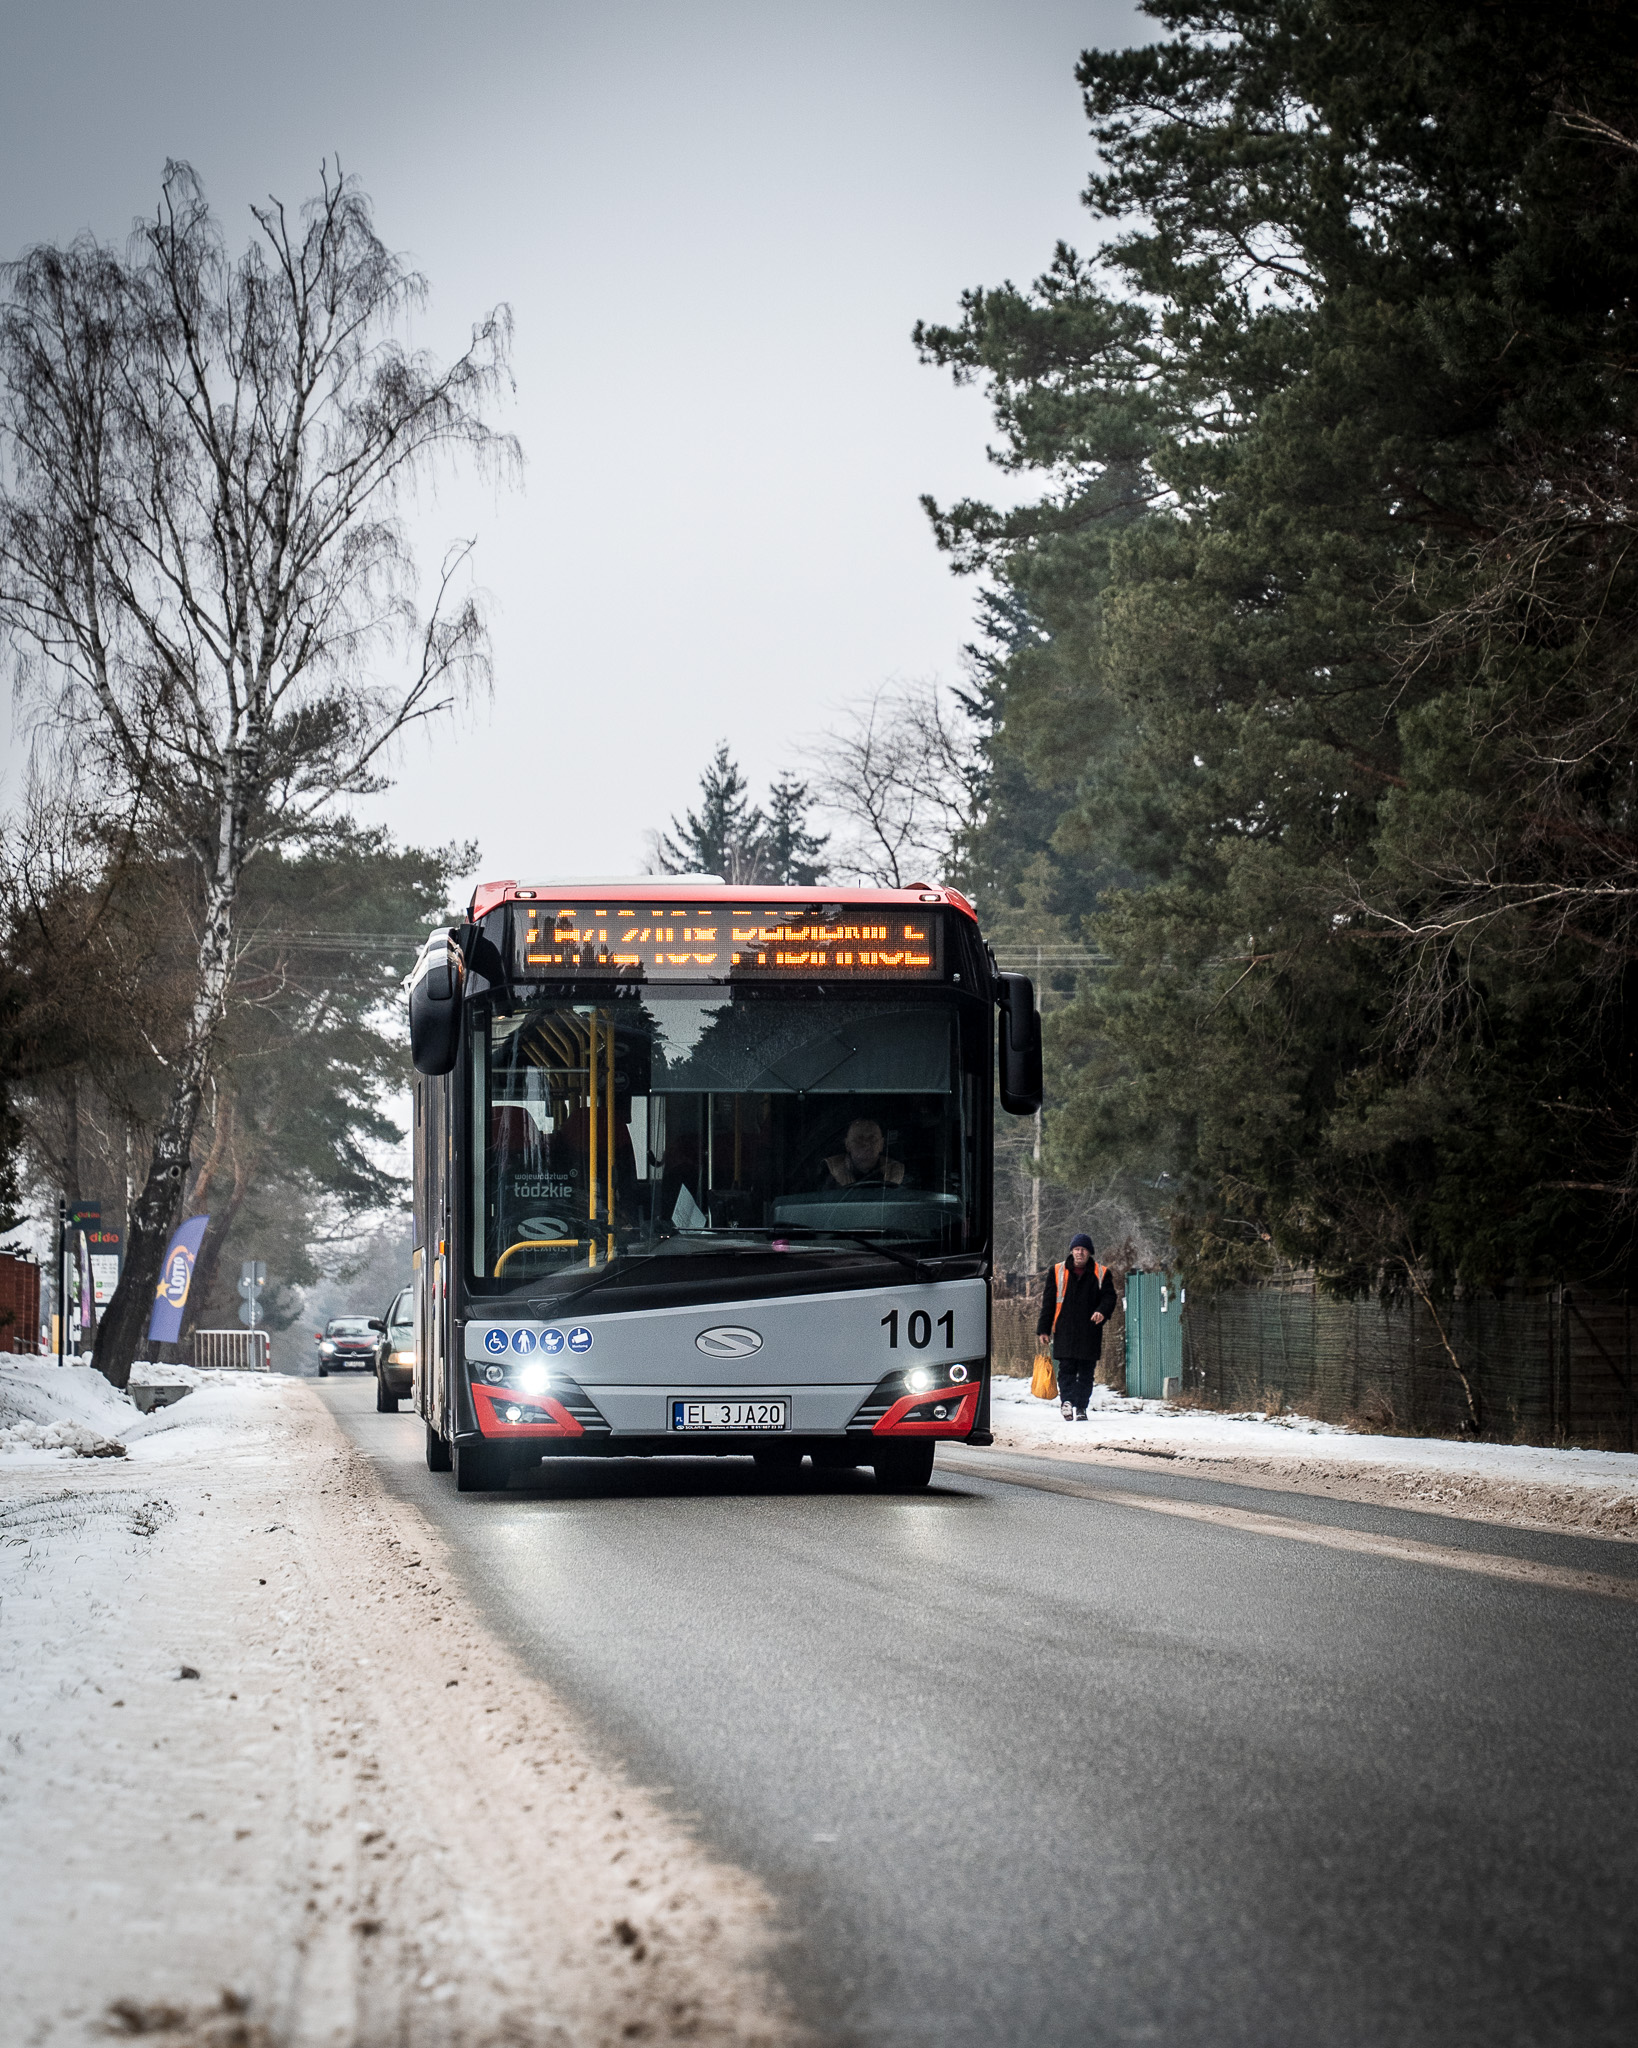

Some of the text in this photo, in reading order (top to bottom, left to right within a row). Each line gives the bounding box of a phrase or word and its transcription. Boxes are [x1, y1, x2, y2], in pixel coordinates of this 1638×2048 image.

[514, 1182, 573, 1198] łódzkie
[89, 1231, 119, 1243] dido
[168, 1256, 186, 1295] LOTTO
[880, 1309, 954, 1349] 101
[688, 1405, 780, 1424] EL 3JA20
